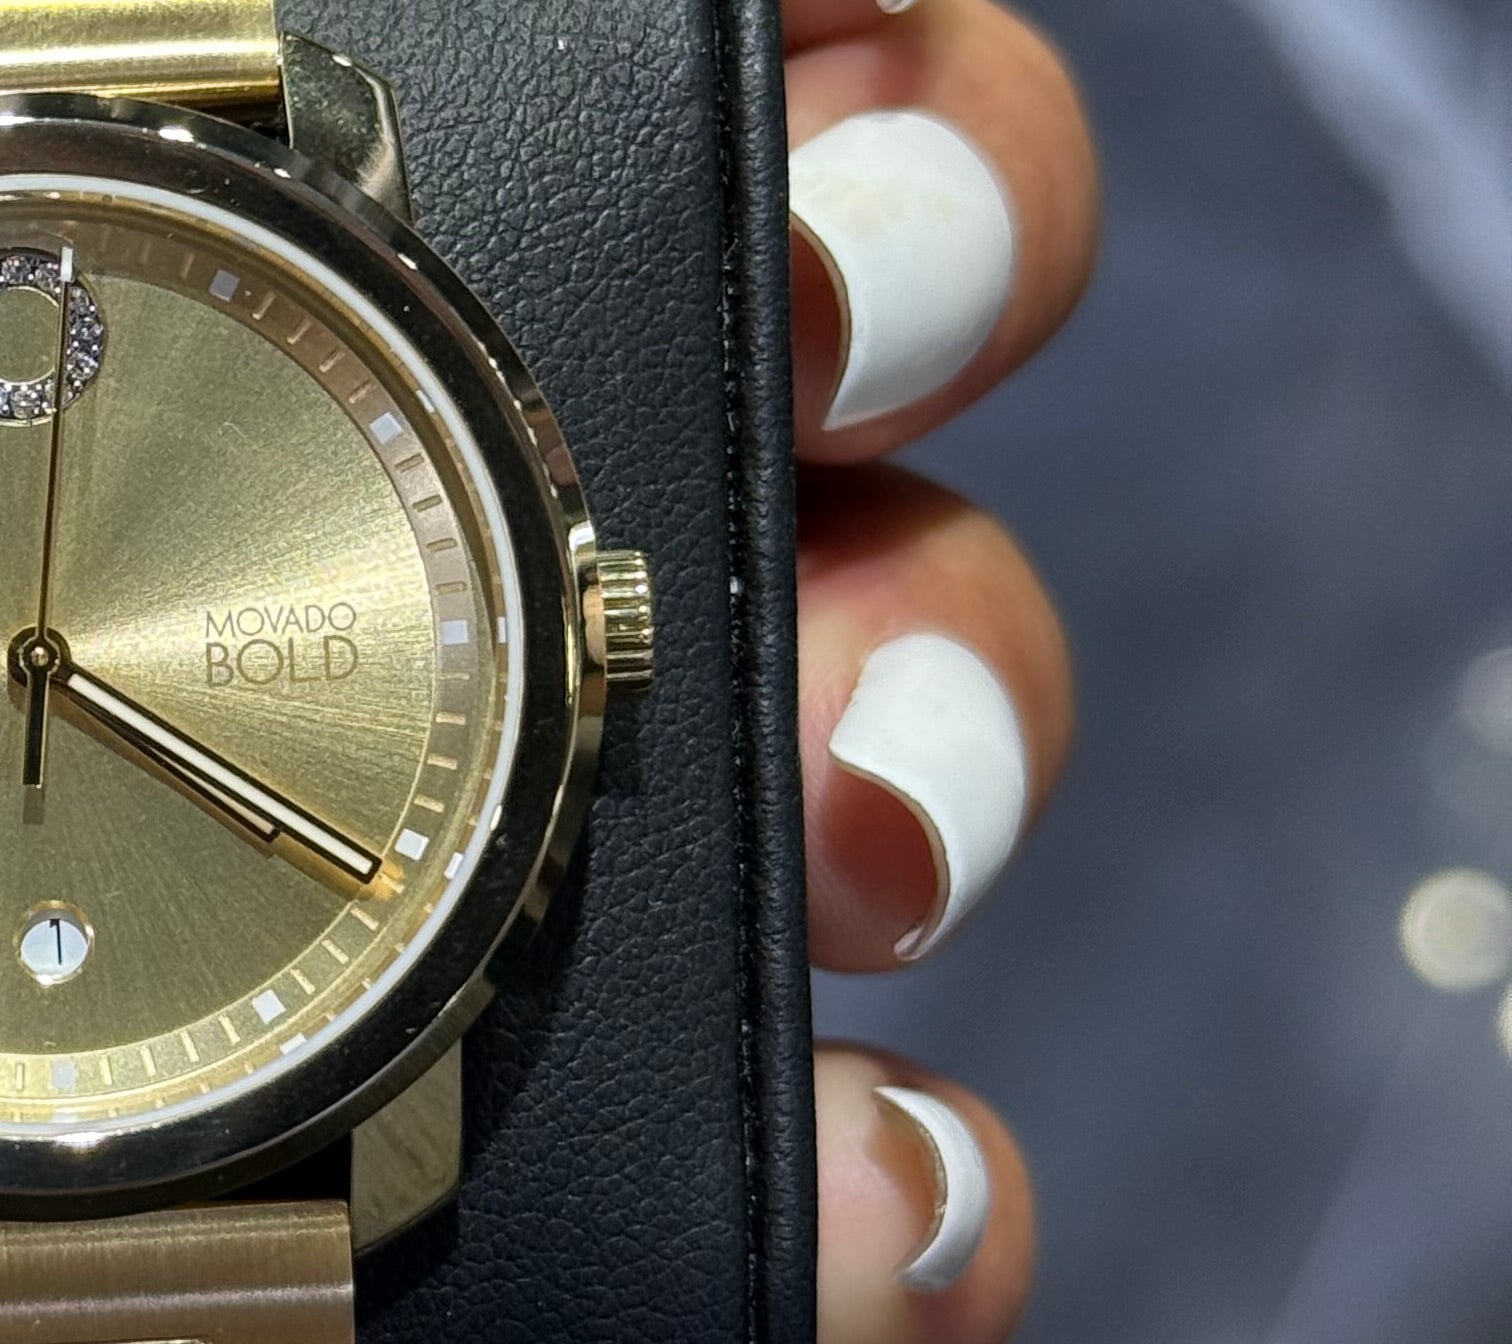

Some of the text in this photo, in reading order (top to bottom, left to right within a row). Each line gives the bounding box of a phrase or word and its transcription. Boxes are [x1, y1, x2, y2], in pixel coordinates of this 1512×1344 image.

[205, 602, 357, 638] MOVADO
[205, 635, 359, 687] BOLD
[49, 918, 62, 965] 1
